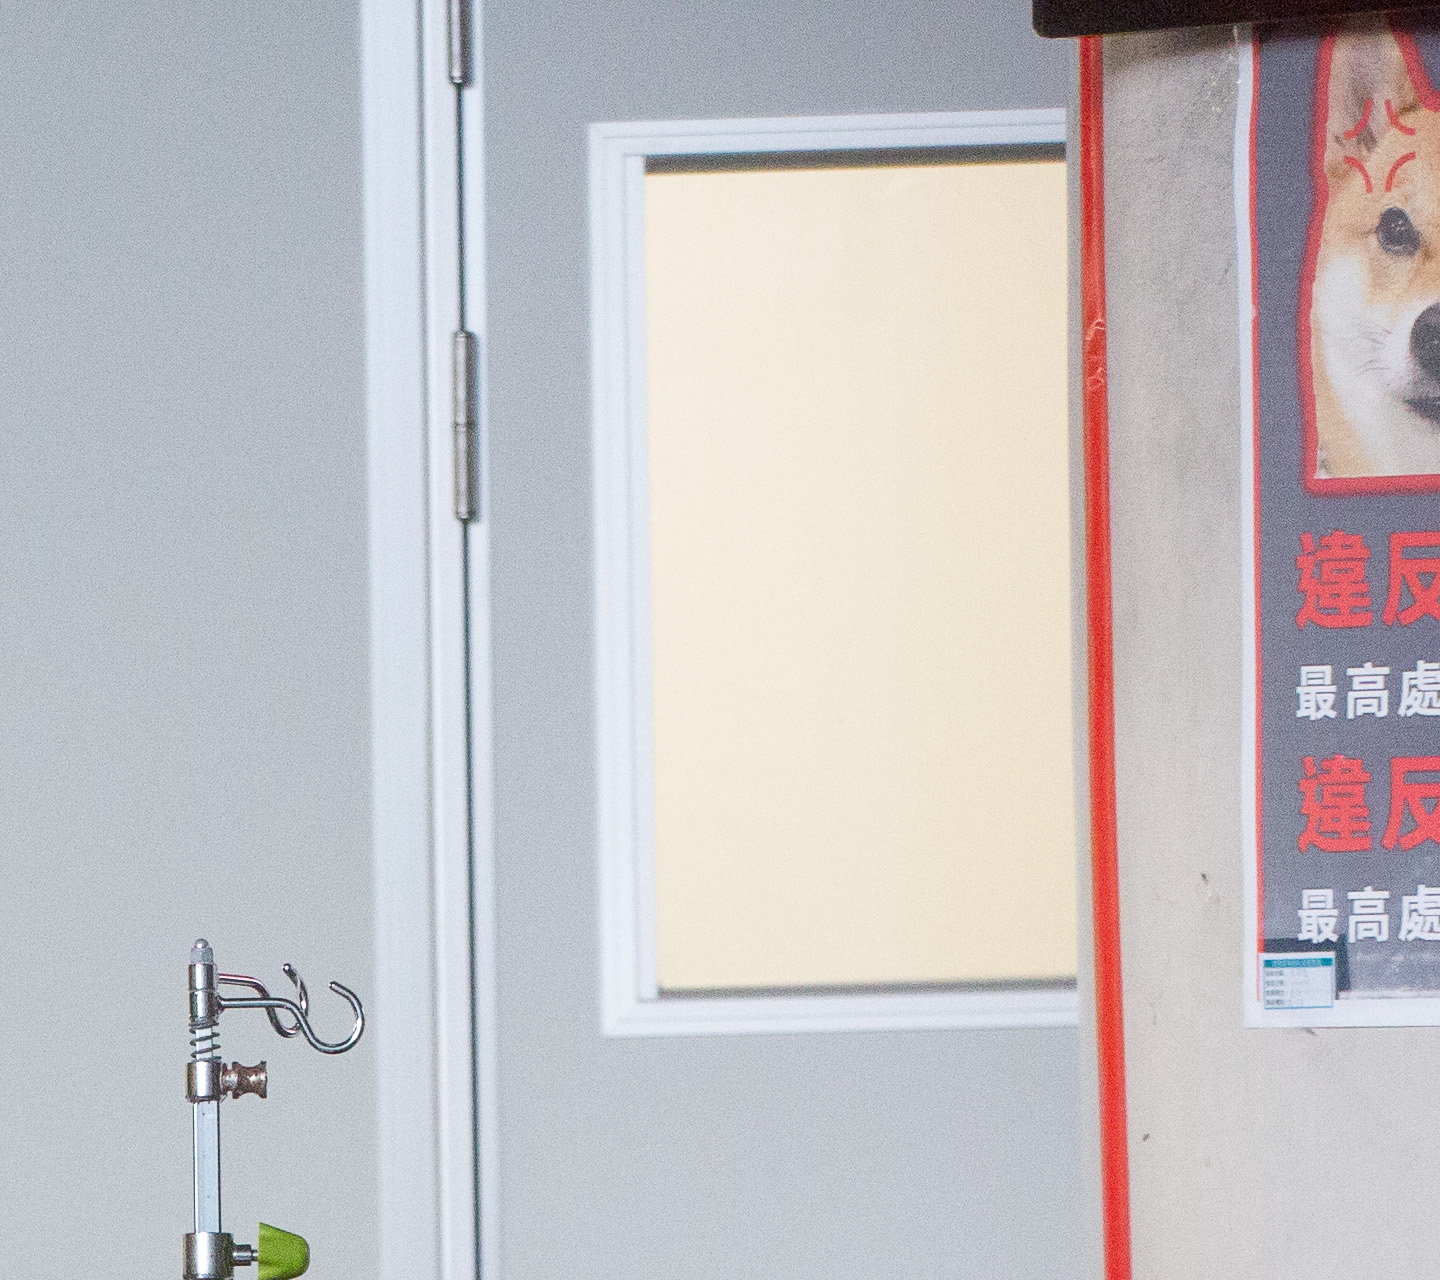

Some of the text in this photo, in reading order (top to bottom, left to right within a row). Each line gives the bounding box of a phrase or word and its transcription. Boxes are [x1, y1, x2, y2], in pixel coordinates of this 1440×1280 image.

[1295, 530, 1440, 631] 違反
[1295, 660, 1440, 721] 最高處
[1297, 755, 1440, 854] 違反
[1297, 885, 1440, 945] 最高處
